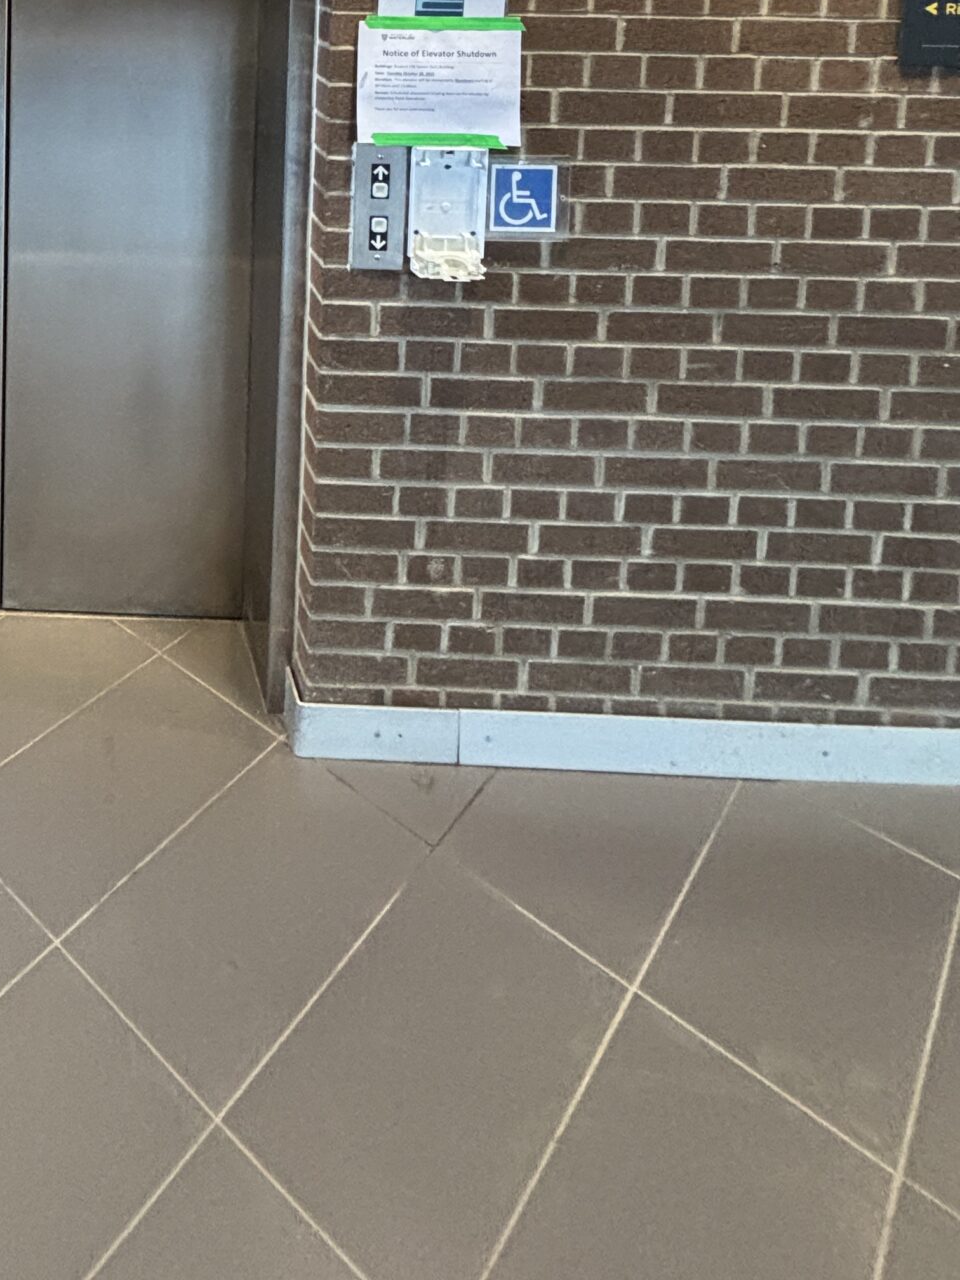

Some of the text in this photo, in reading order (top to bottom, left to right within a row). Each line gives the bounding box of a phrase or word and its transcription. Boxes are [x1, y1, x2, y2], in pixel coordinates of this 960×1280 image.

[382, 49, 497, 58] Notice of Elevator Shutdown
